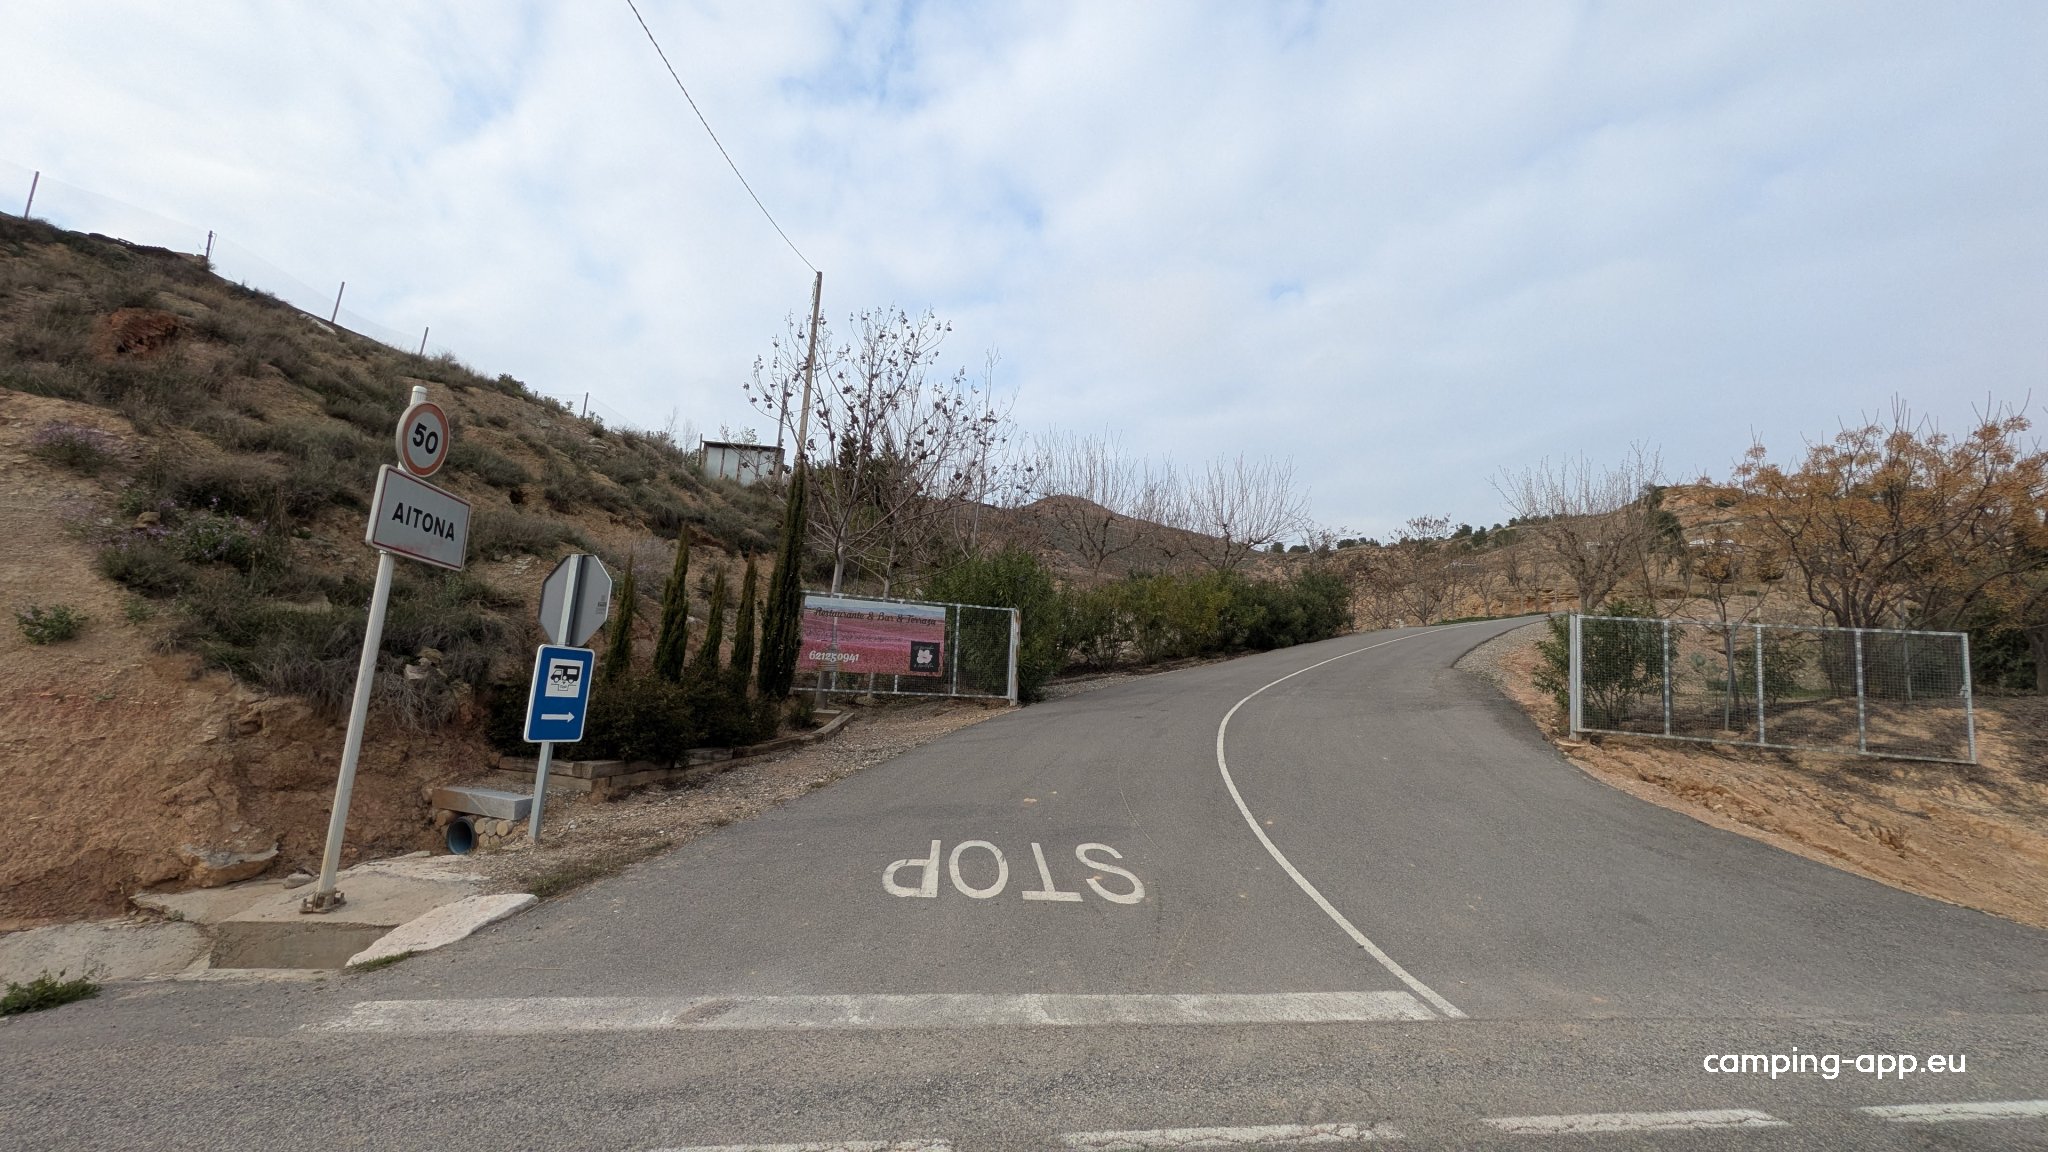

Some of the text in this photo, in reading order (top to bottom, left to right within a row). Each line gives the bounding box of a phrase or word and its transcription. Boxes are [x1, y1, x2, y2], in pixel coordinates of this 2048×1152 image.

[412, 422, 439, 455] 50
[391, 502, 455, 542] AITONA
[814, 606, 865, 620] Restaurante
[867, 611, 874, 622] &
[877, 611, 894, 622] Bar
[896, 614, 905, 624] &
[808, 650, 860, 664] 621250941
[881, 839, 1146, 905] STOP
